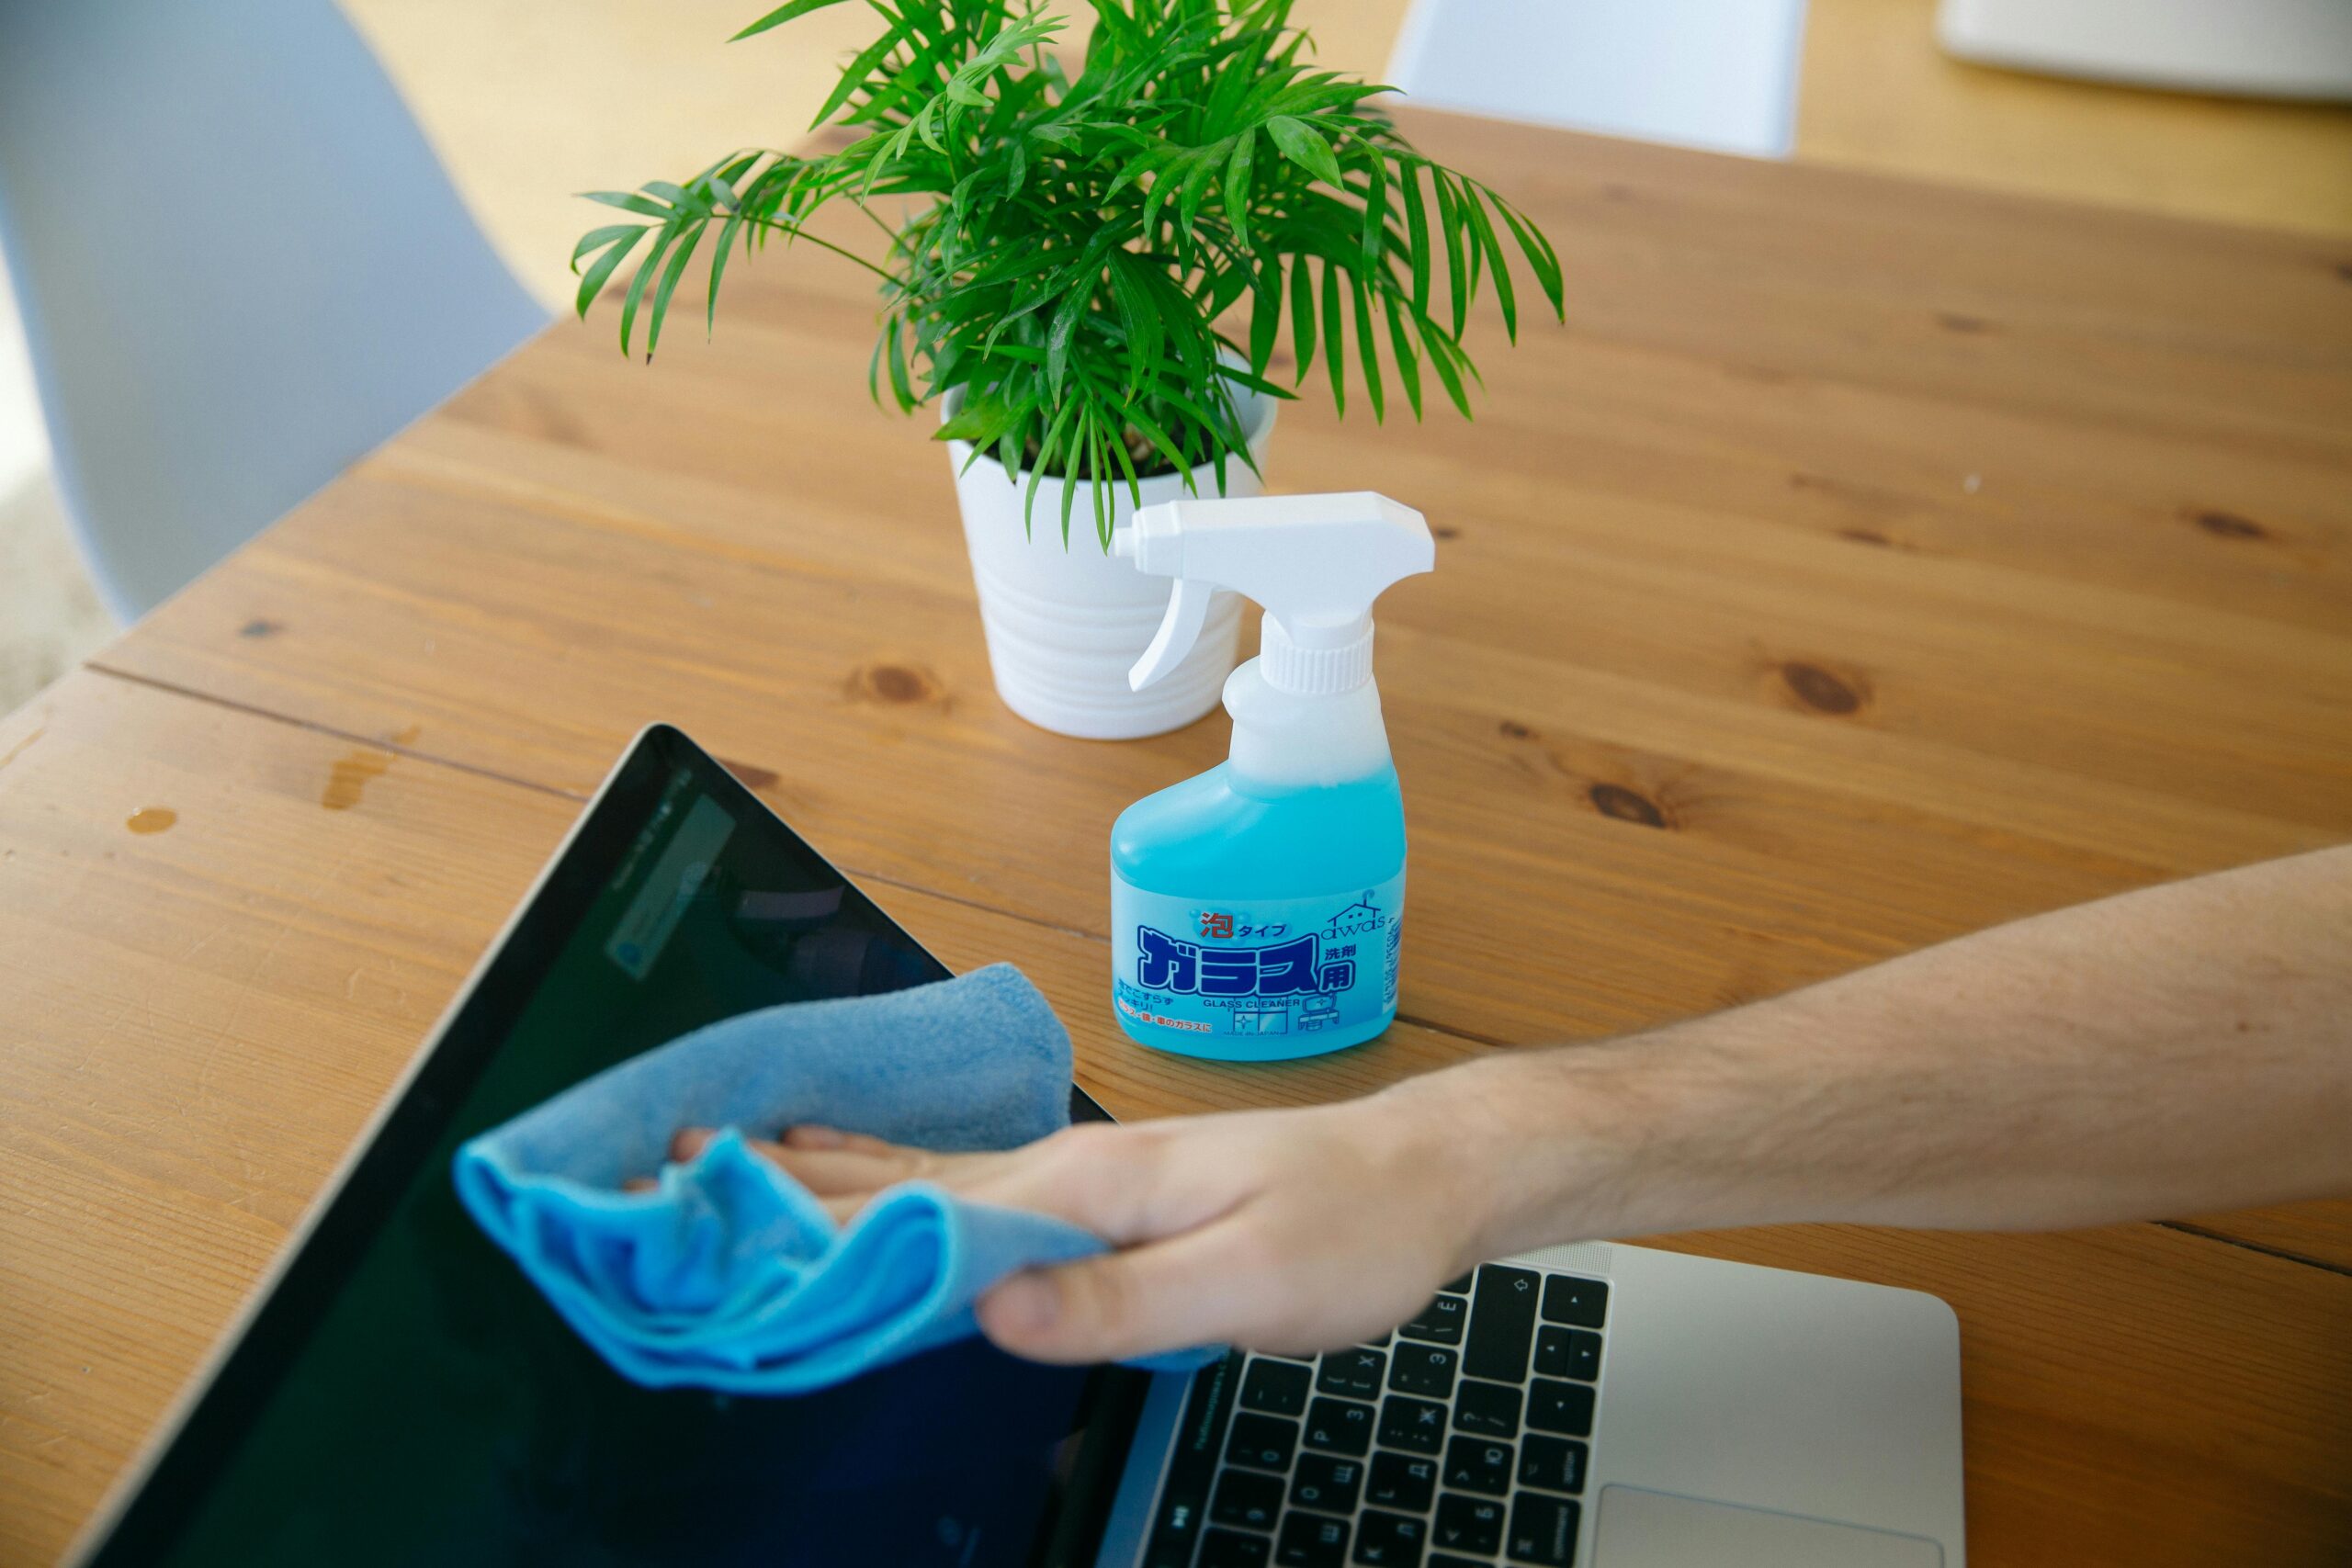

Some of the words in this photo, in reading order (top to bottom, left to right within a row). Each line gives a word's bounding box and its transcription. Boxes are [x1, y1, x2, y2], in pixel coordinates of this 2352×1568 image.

[1203, 999, 1242, 1009] GLASS
[1245, 998, 1300, 1009] CLEANER
[1419, 1409, 1437, 1424] Ж
[1484, 1448, 1504, 1466] Ю
